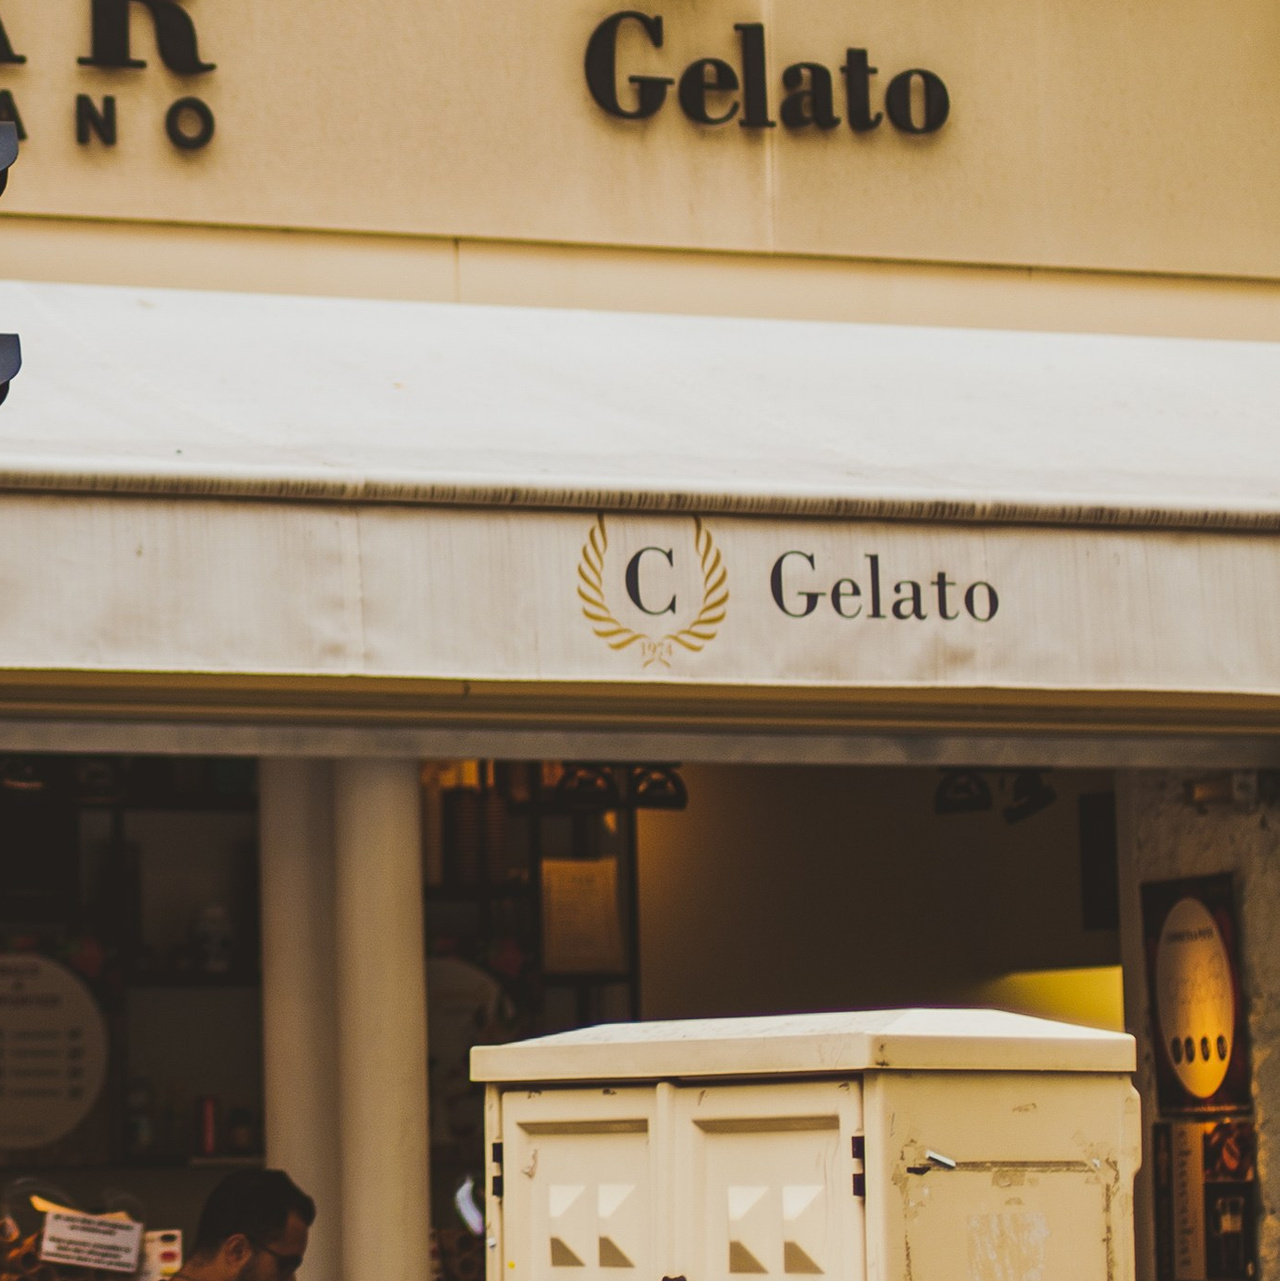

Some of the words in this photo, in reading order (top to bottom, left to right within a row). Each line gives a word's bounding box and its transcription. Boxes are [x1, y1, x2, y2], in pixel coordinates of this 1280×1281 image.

[584, 10, 951, 135] Gelato
[625, 546, 677, 616] C
[770, 550, 1000, 622] Gelato
